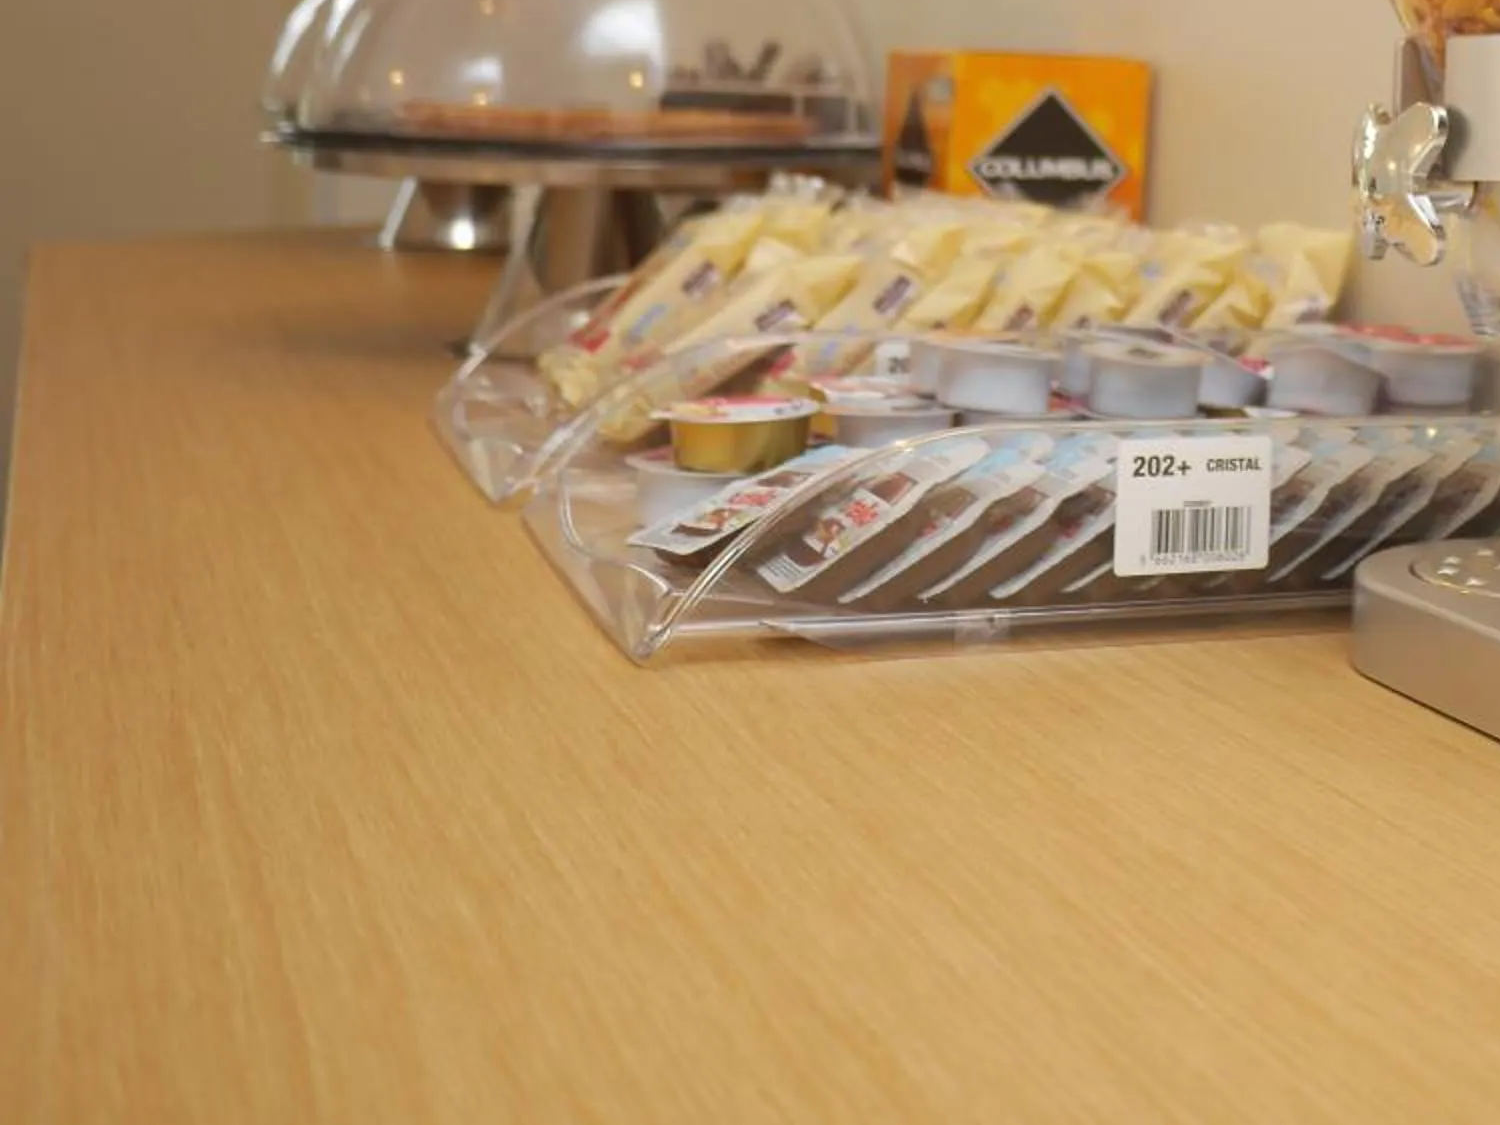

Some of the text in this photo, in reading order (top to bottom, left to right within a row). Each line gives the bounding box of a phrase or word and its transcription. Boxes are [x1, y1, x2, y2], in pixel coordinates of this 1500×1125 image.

[980, 158, 1112, 180] COLUMBUS
[1133, 455, 1262, 477] 202+ CRISTAL
